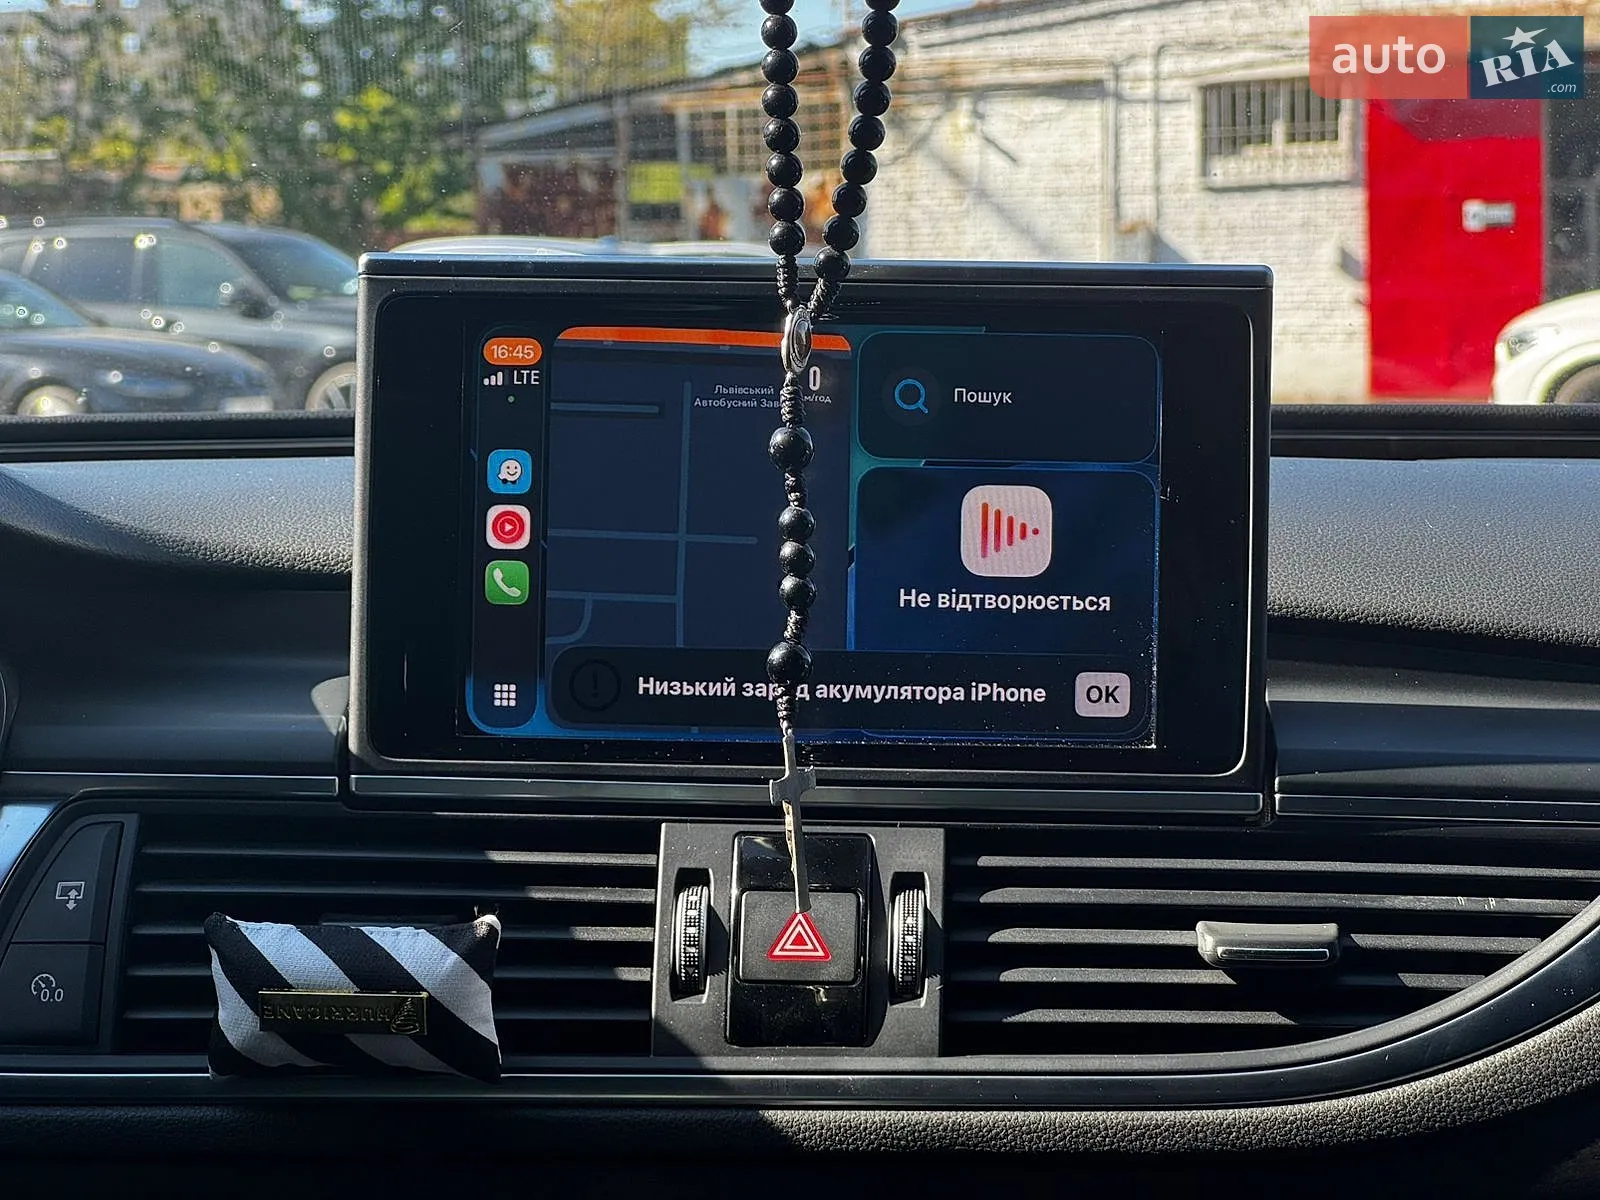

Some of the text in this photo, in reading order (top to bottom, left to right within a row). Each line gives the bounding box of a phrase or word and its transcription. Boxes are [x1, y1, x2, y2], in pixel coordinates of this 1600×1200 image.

[491, 344, 535, 359] 16:45
[513, 370, 540, 385] LTE
[809, 366, 821, 391] 0
[714, 384, 775, 396] Львівський
[953, 387, 1012, 406] Пошук
[694, 397, 757, 409] Автобусний
[899, 588, 1111, 613] Не відтворюється
[638, 676, 1047, 705] Низький зард акумулятора iPhone
[1085, 684, 1120, 705] OK
[40, 988, 64, 1002] 0.0
[262, 1002, 393, 1023] HURRICANE
